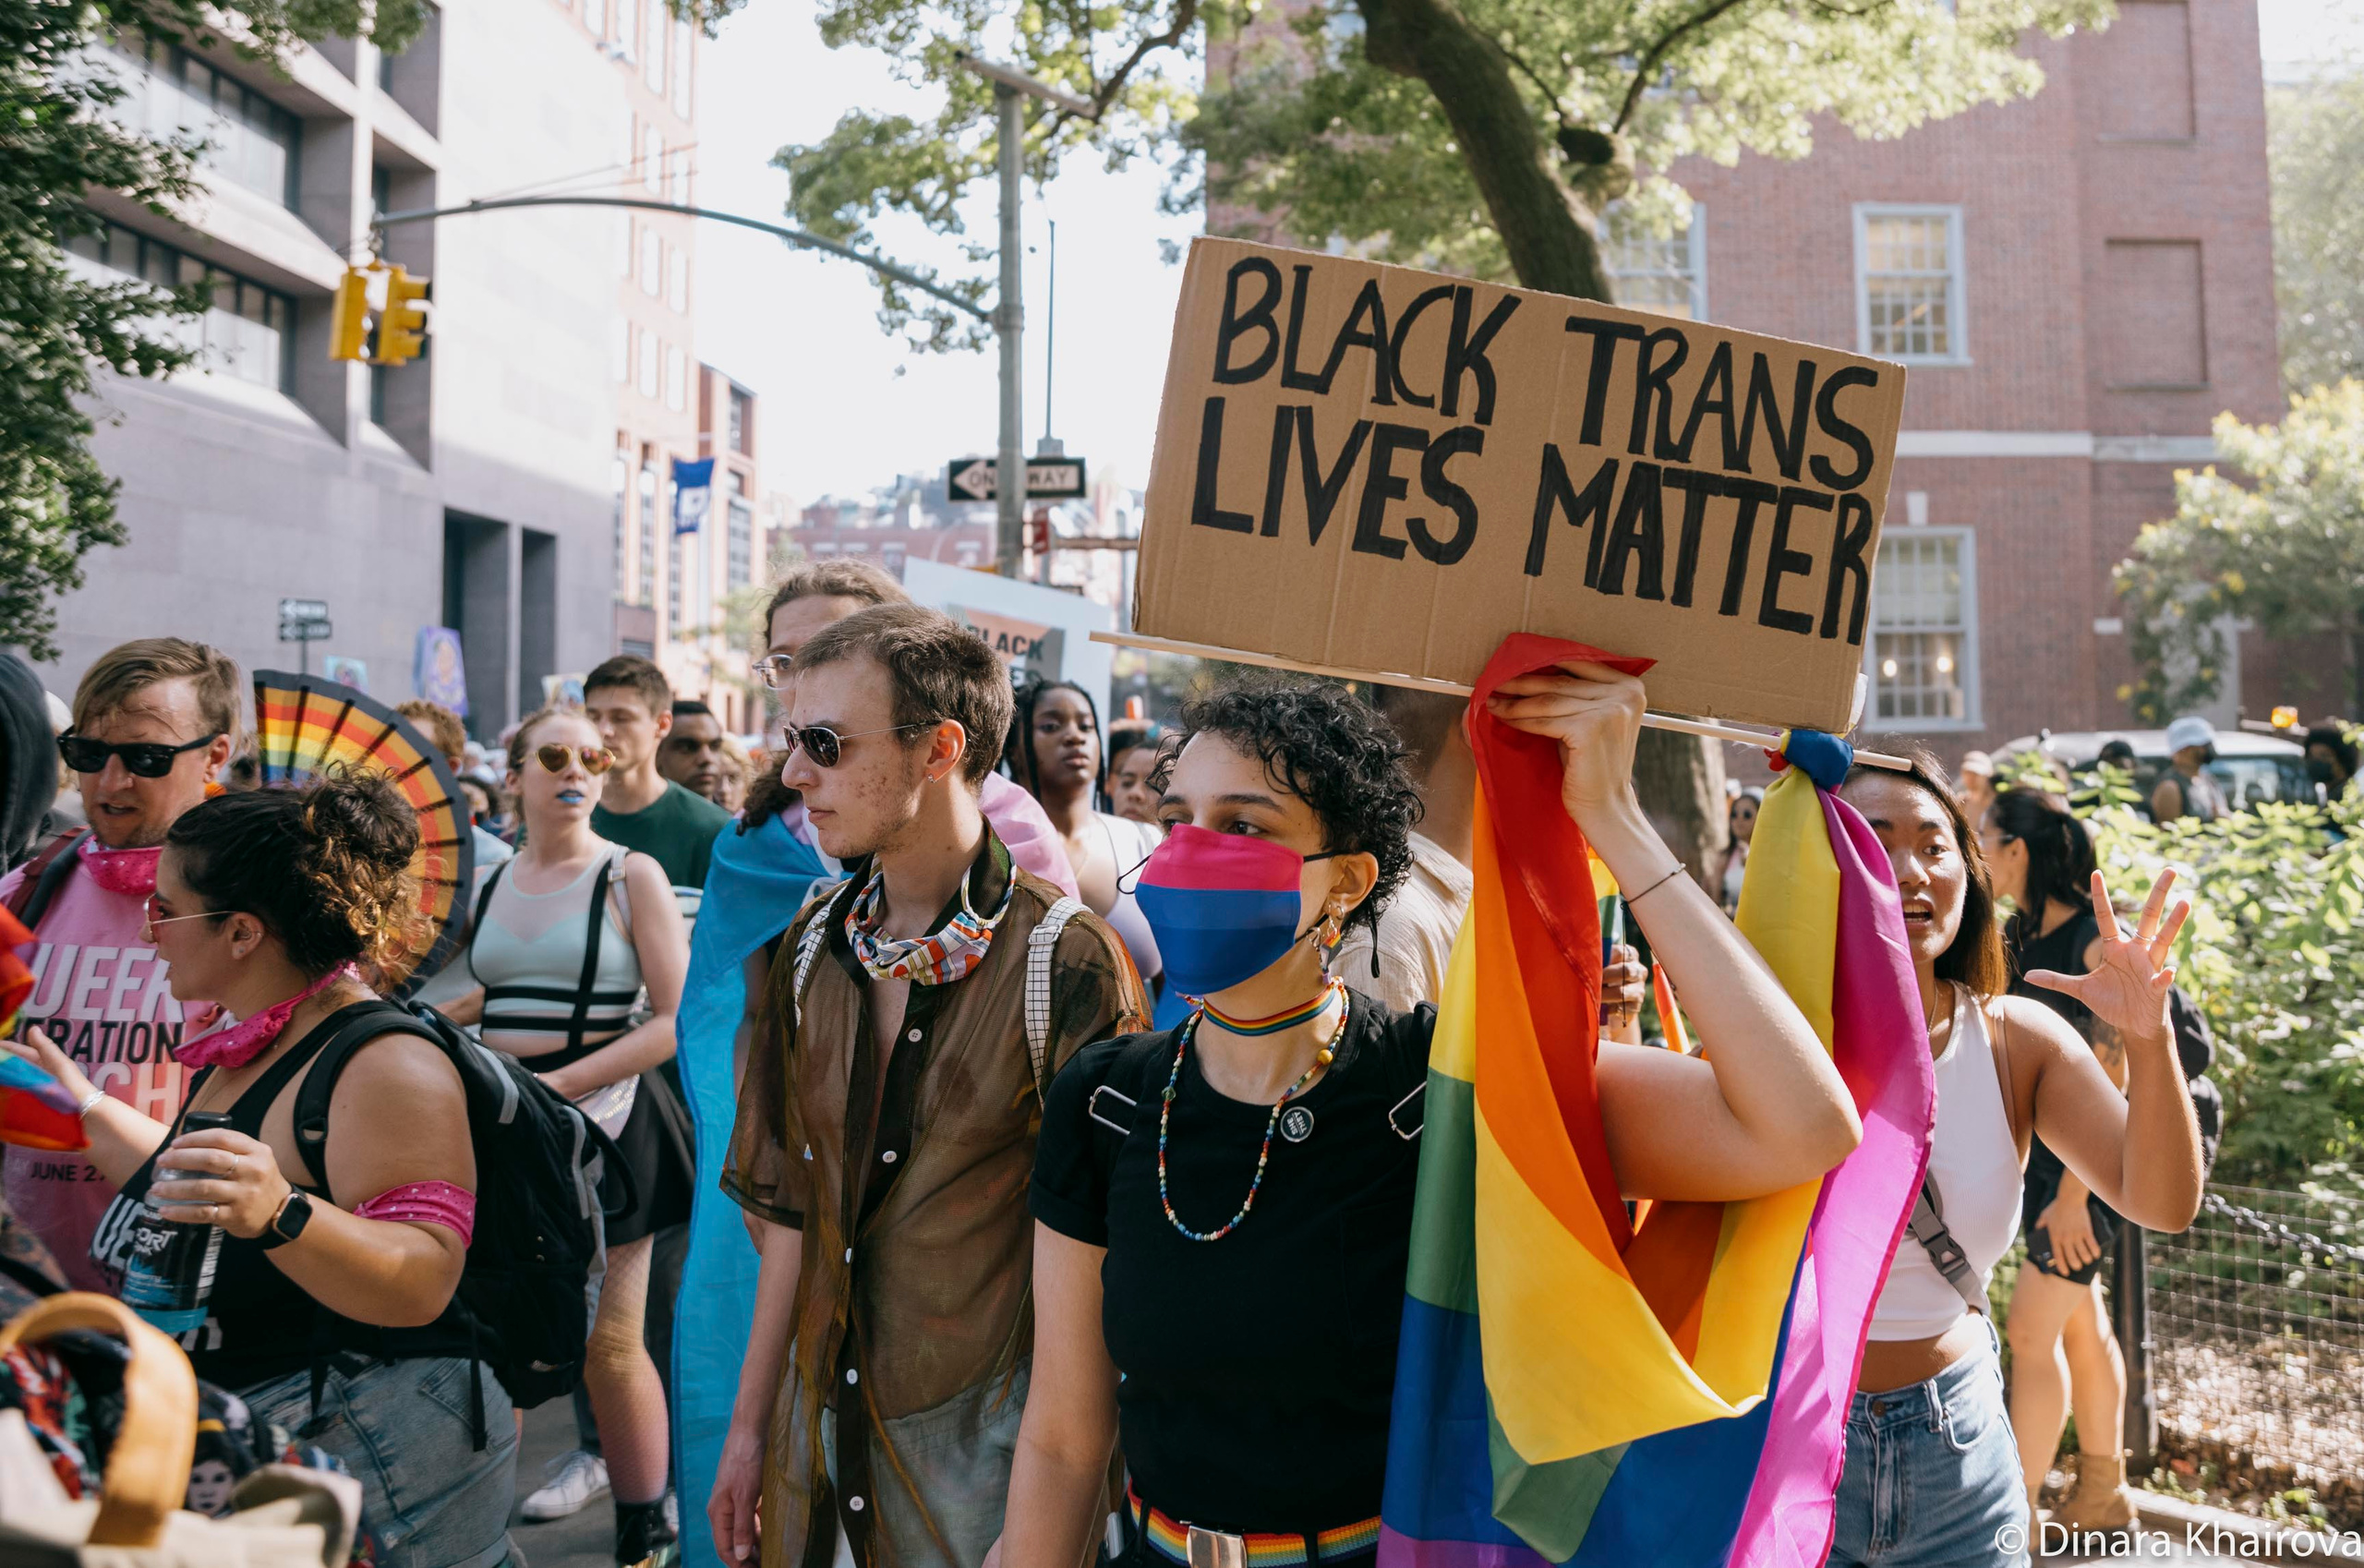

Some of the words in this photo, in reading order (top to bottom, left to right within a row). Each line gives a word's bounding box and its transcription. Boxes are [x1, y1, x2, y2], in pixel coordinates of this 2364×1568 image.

[1212, 257, 1522, 426] BLACK
[1565, 316, 1878, 490] TRANS
[970, 471, 996, 487] ON
[1028, 470, 1067, 485] WAY
[1191, 397, 1485, 565] LIVES
[1524, 443, 1873, 645] MATTER
[967, 624, 1043, 661] ACK
[25, 943, 185, 1022] UEER
[5, 1017, 183, 1064] RATION
[30, 1162, 78, 1181] JUNE
[136, 1226, 178, 1252] ORT
